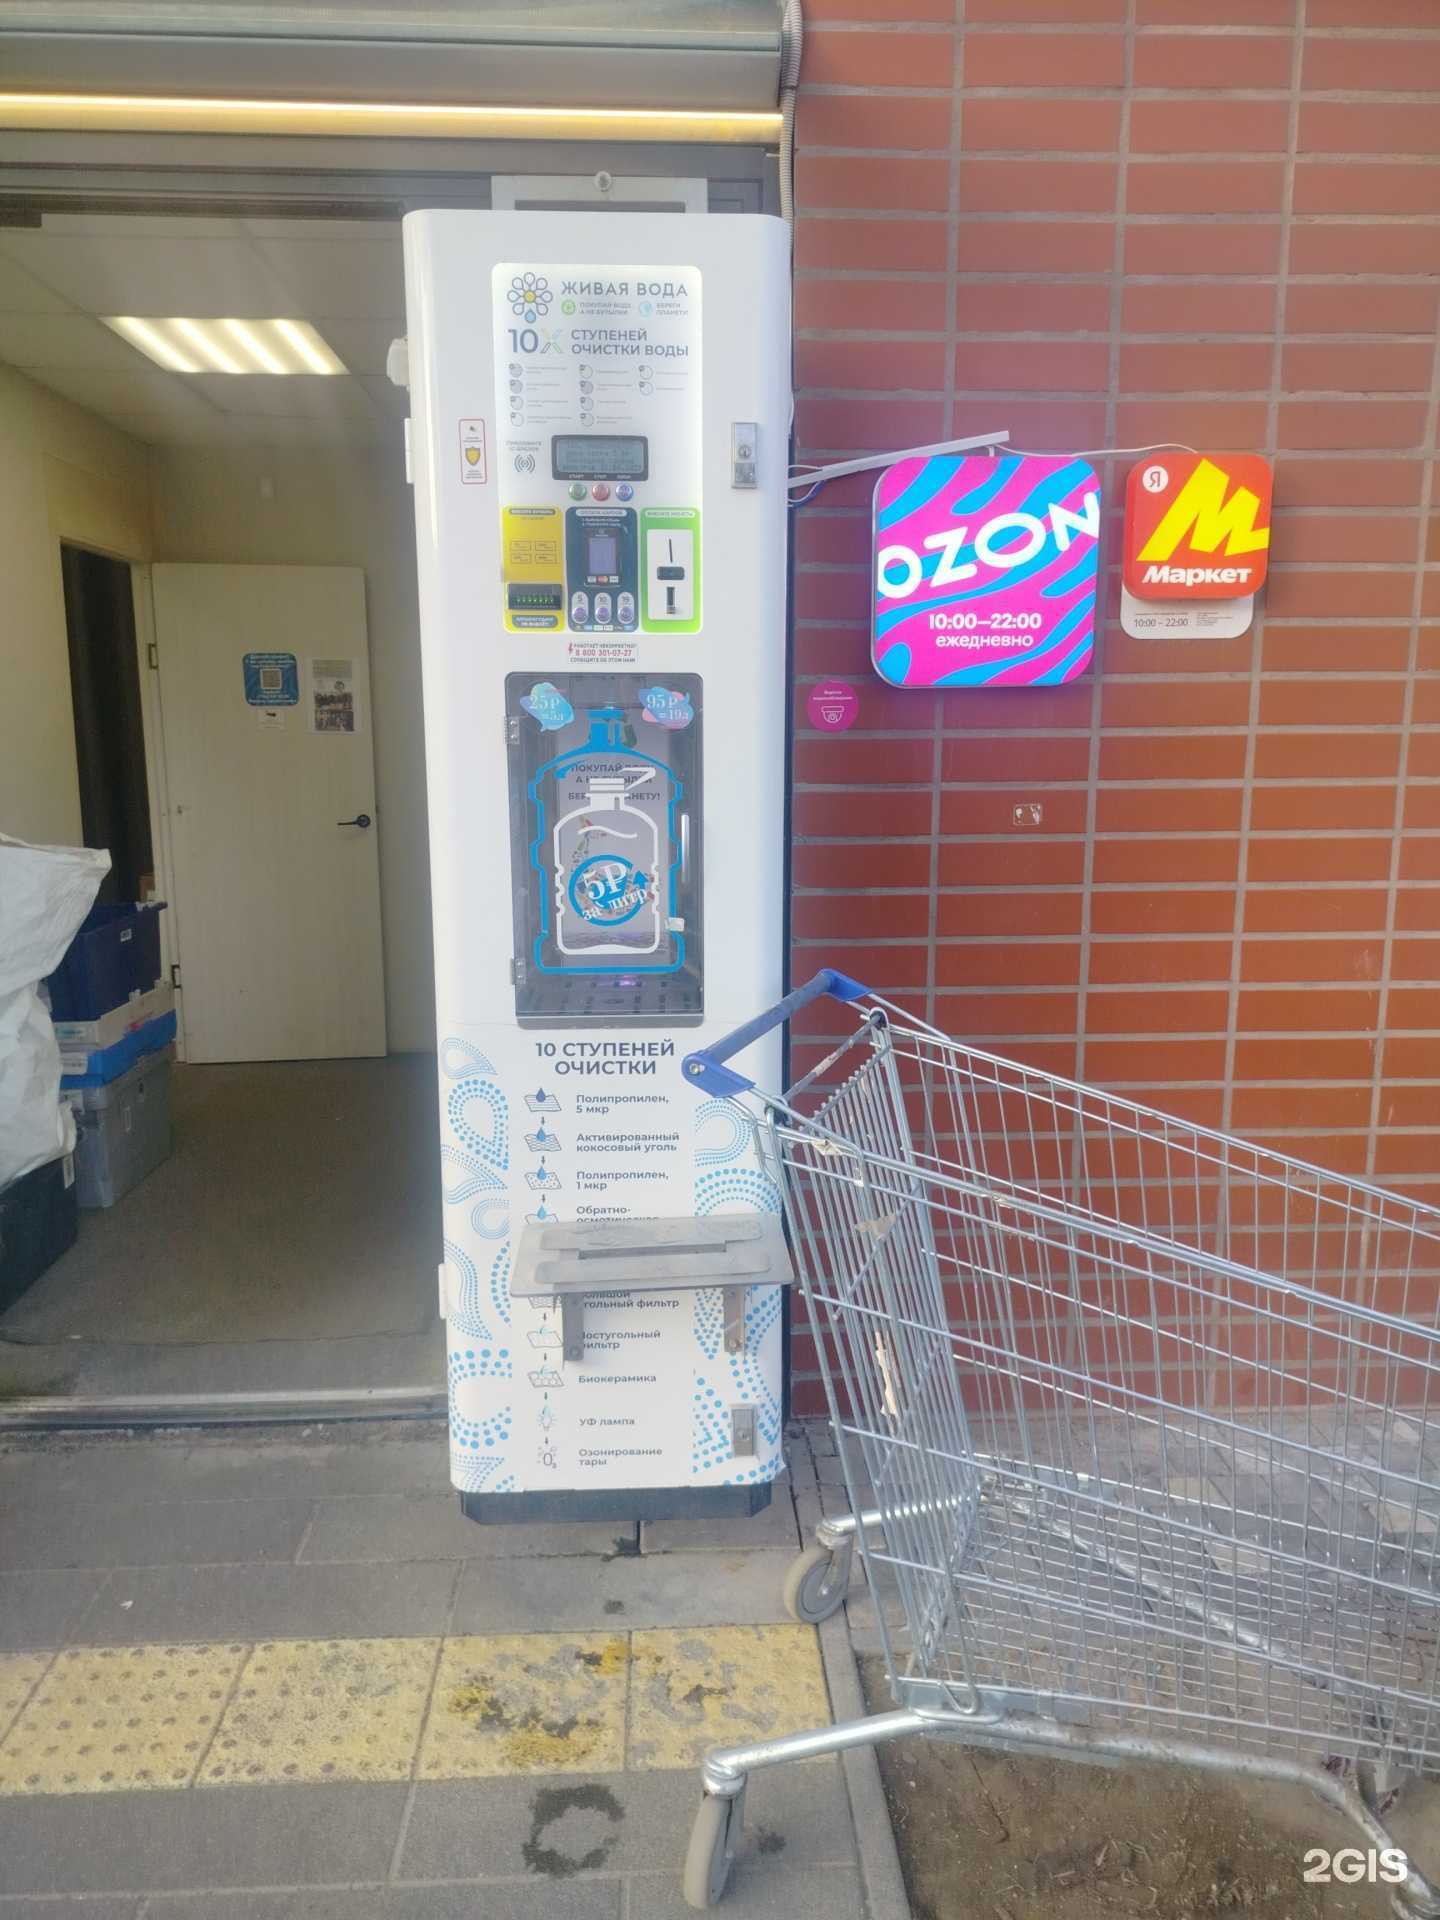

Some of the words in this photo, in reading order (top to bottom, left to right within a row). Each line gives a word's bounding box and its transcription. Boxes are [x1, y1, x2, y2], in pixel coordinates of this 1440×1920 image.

[561, 281, 630, 296] ЖИВАЯ
[636, 282, 688, 299] ВОДА
[570, 327, 648, 341] СТУПЕНЕЙ
[570, 343, 640, 355] ОЧИСТКИ
[644, 344, 689, 358] ВОДЫ
[1149, 470, 1161, 488] Я
[877, 491, 1101, 599] OZON
[1141, 564, 1253, 587] Маркет
[935, 634, 1035, 649] ежедневно
[535, 1042, 556, 1057] 10
[562, 1039, 675, 1057] СТУПЕНЕЙ
[554, 1060, 657, 1075] ОЧИСТКИ
[576, 1094, 670, 1105] Полипропилен,
[576, 1104, 583, 1113] 5
[585, 1106, 609, 1115] мкр
[576, 1132, 680, 1144] Активированный
[576, 1142, 641, 1152] кокосовый
[644, 1144, 677, 1153] уголь
[576, 1171, 669, 1182] Полипропилен,
[576, 1181, 581, 1190] 1
[584, 1182, 608, 1191] мкр
[576, 1205, 632, 1216] Обратно-
[583, 1300, 634, 1309] гольный
[636, 1299, 680, 1309] фильтр
[578, 1374, 657, 1385] Биокерамика
[579, 1417, 597, 1426] УФ
[599, 1418, 635, 1426] лампа
[578, 1447, 663, 1457] Озонирование
[579, 1458, 607, 1467] тары
